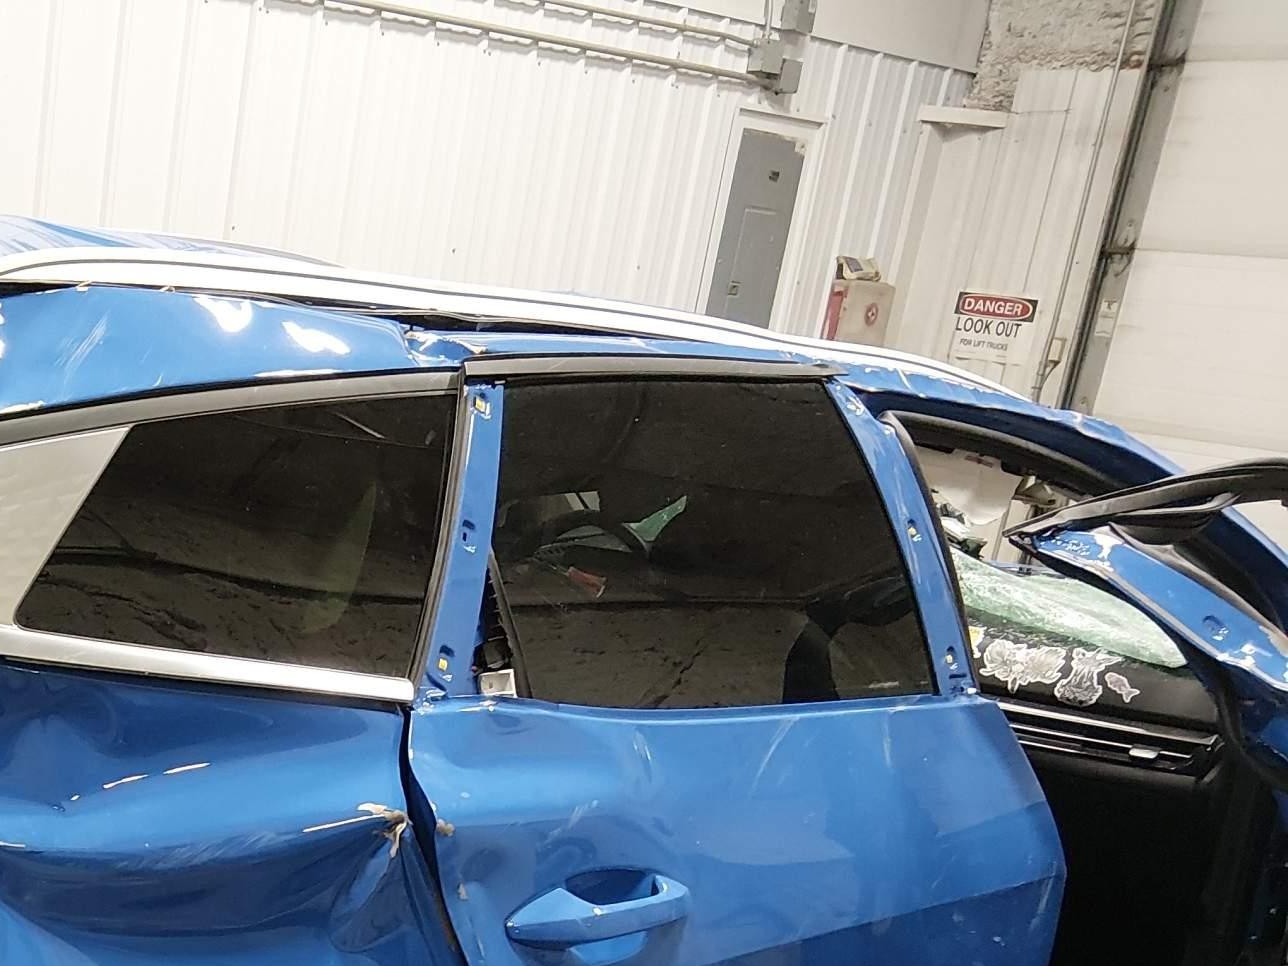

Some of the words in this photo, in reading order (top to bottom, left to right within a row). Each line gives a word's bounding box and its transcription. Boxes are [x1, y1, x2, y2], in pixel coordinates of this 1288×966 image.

[964, 298, 1023, 316] DANGER
[955, 317, 993, 335] LOOK
[995, 321, 1022, 338] OUT
[959, 338, 972, 346] FOR
[973, 339, 986, 348] LIFT
[986, 341, 1008, 351] TRUCKS
